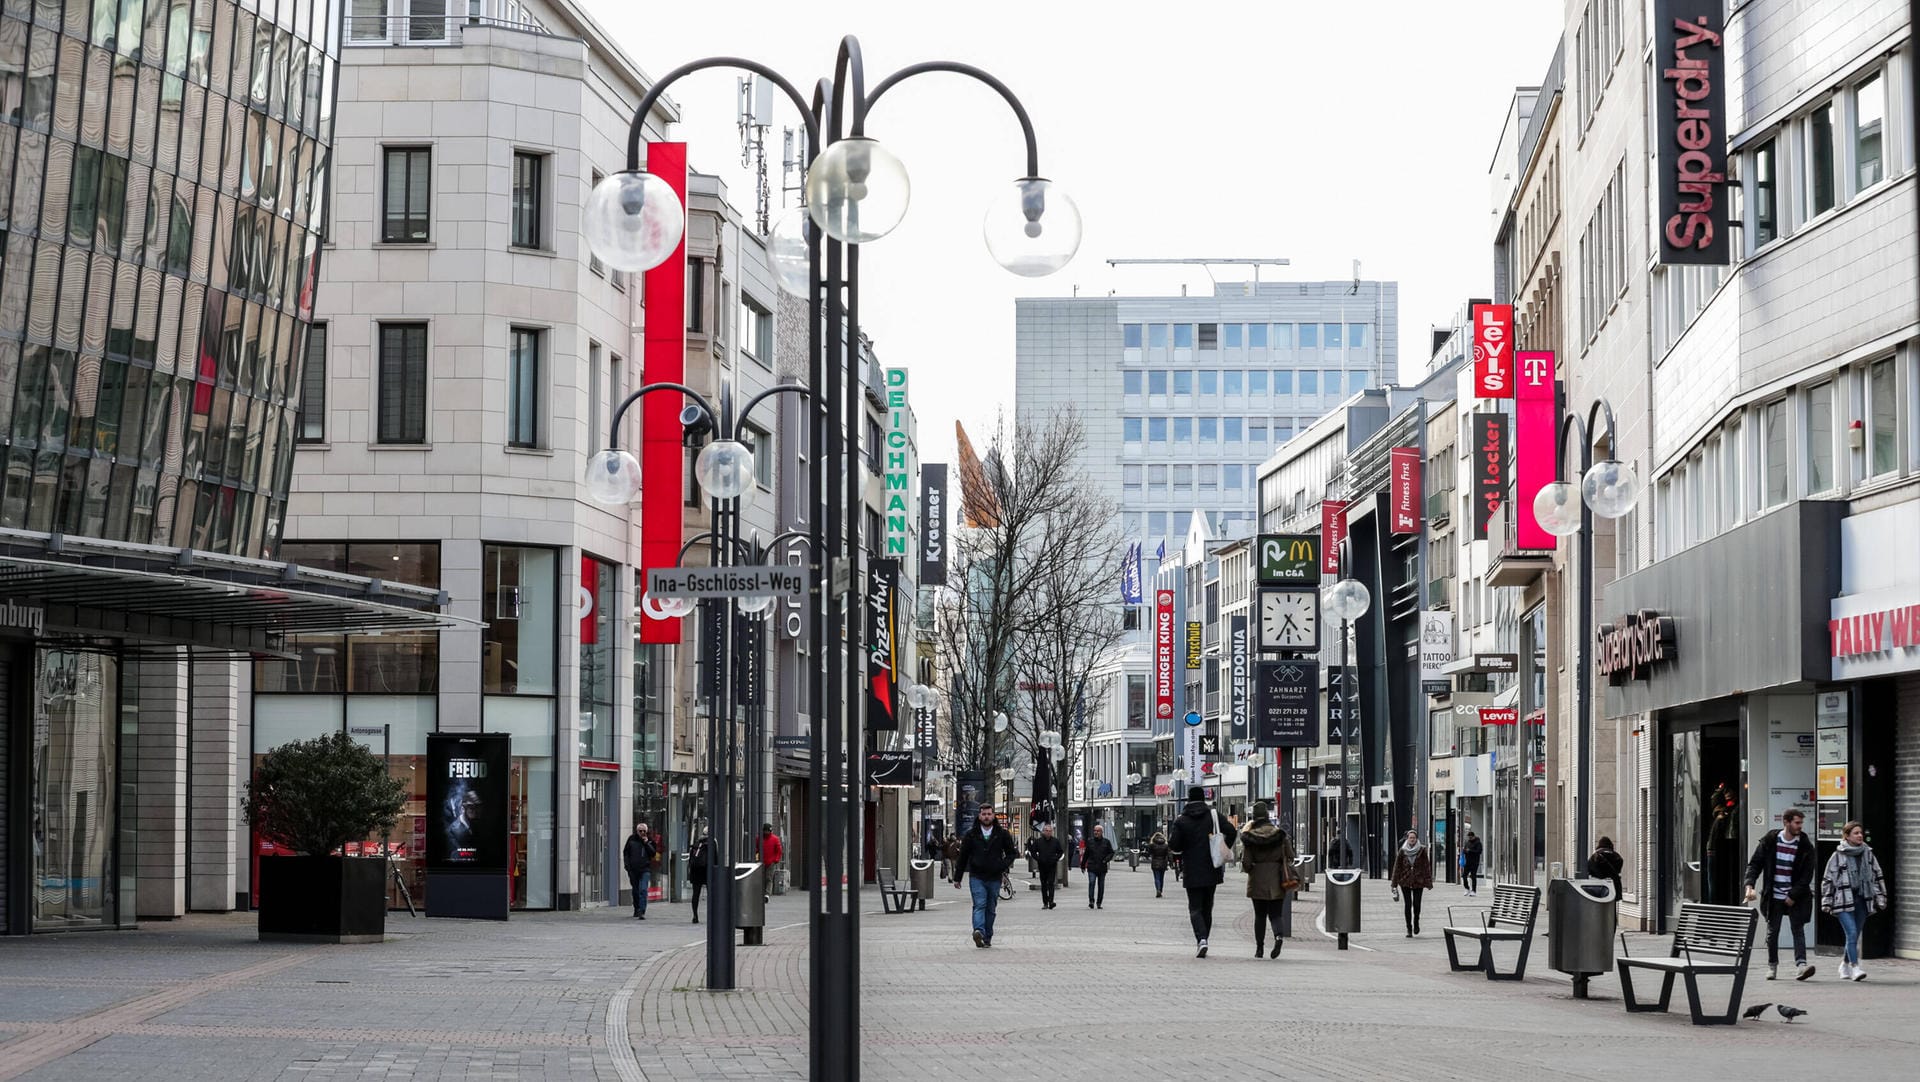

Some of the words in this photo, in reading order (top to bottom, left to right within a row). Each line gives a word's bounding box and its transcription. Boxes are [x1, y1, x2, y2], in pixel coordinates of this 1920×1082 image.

[1664, 16, 1724, 250] Superdry.
[1524, 359, 1547, 385] T
[886, 370, 908, 554] DEICHMANN
[1482, 420, 1500, 485] Locker
[926, 486, 940, 562] Kraemer
[654, 572, 801, 594] Ina-Gschlössl-Weg
[870, 569, 888, 613] Hut
[871, 615, 891, 670] Pizza
[1160, 613, 1170, 644] KING
[1186, 622, 1200, 668] Fahrschule
[1828, 612, 1884, 657] TALLY
[1160, 647, 1170, 697] BURGER
[1234, 629, 1245, 726] CALZEDONIA
[916, 708, 935, 747] snipe
[1330, 674, 1342, 737] ZARA
[1203, 738, 1215, 752] WMF
[449, 761, 487, 778] FREUD
